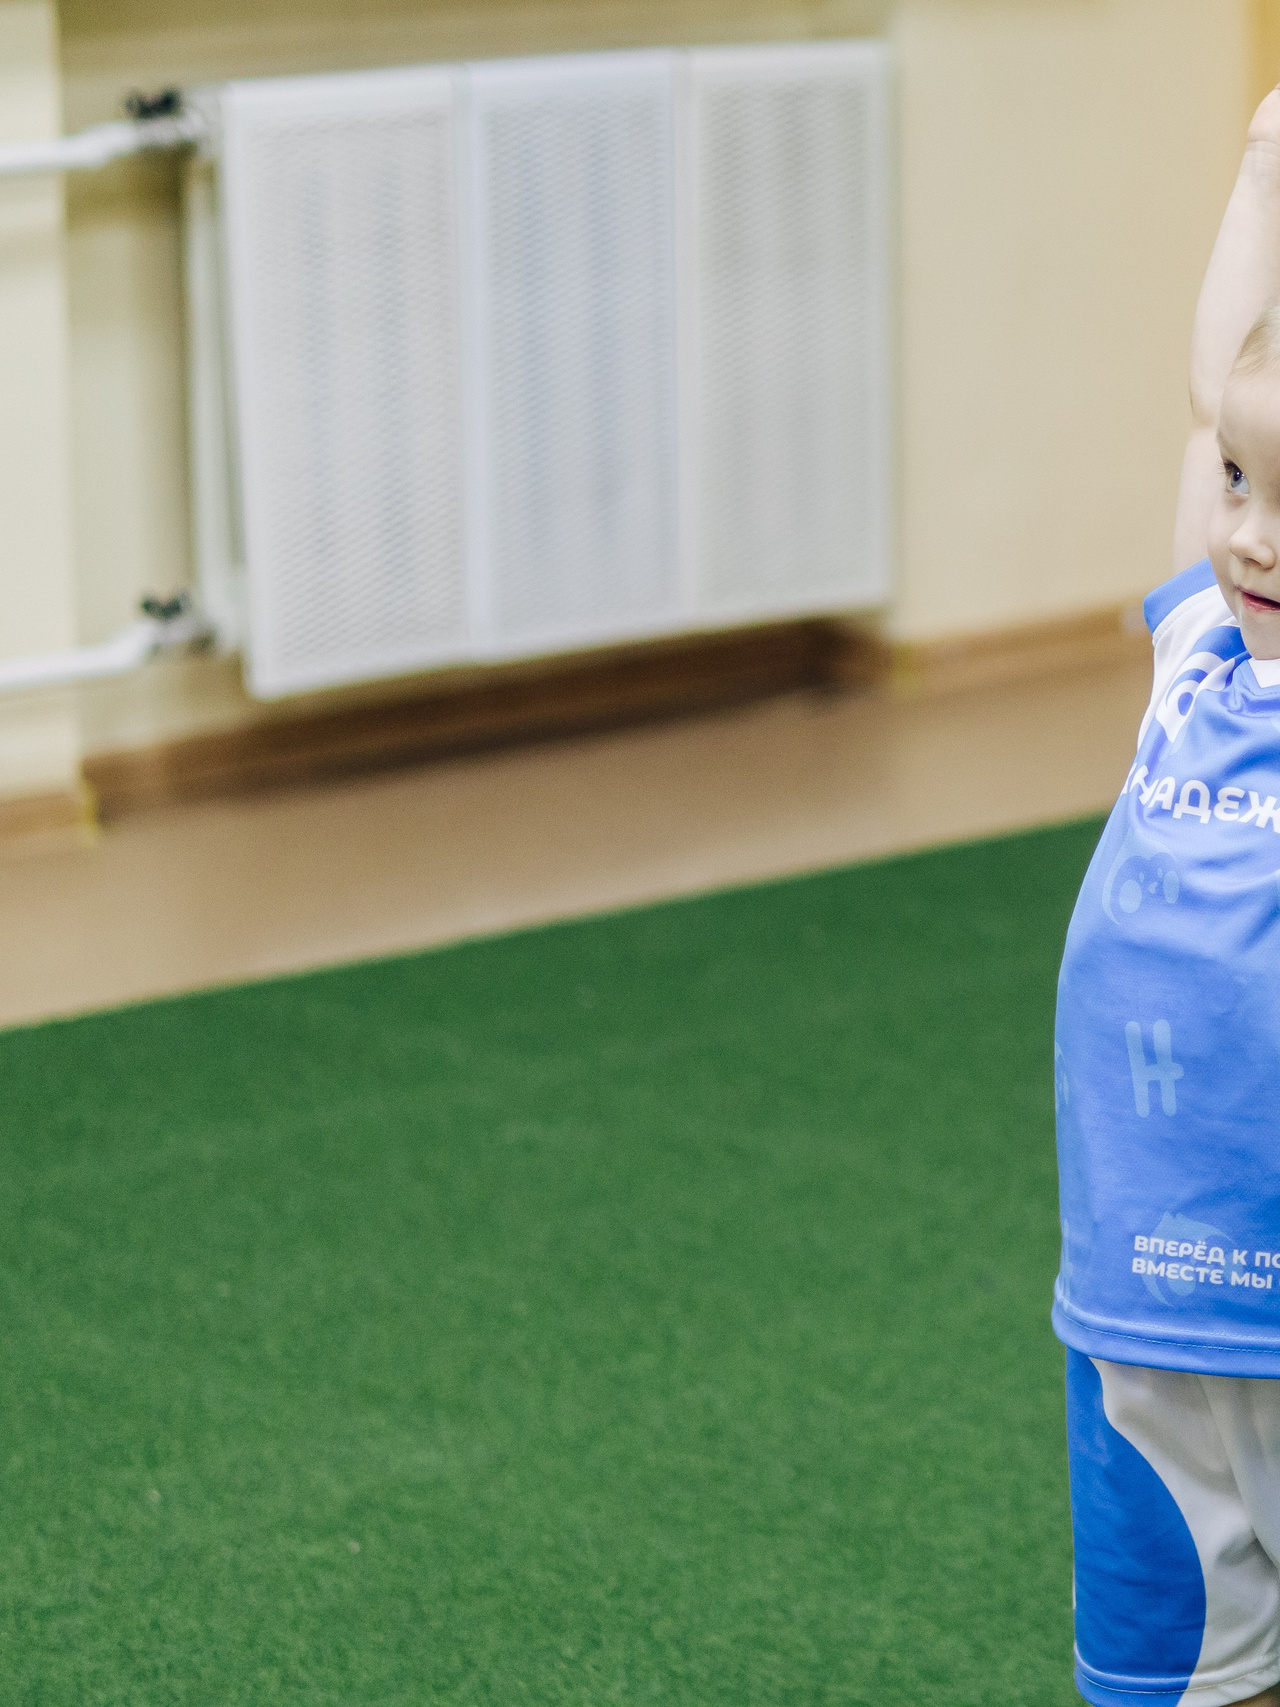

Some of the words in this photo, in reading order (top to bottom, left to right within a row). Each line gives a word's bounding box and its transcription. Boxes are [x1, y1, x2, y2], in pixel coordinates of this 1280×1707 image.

[1133, 1235, 1226, 1266] ВПЕРЁД
[1232, 1250, 1248, 1266] К
[1131, 1257, 1225, 1285] ВМЕСТЕ
[1230, 1271, 1273, 1289] МЫ
